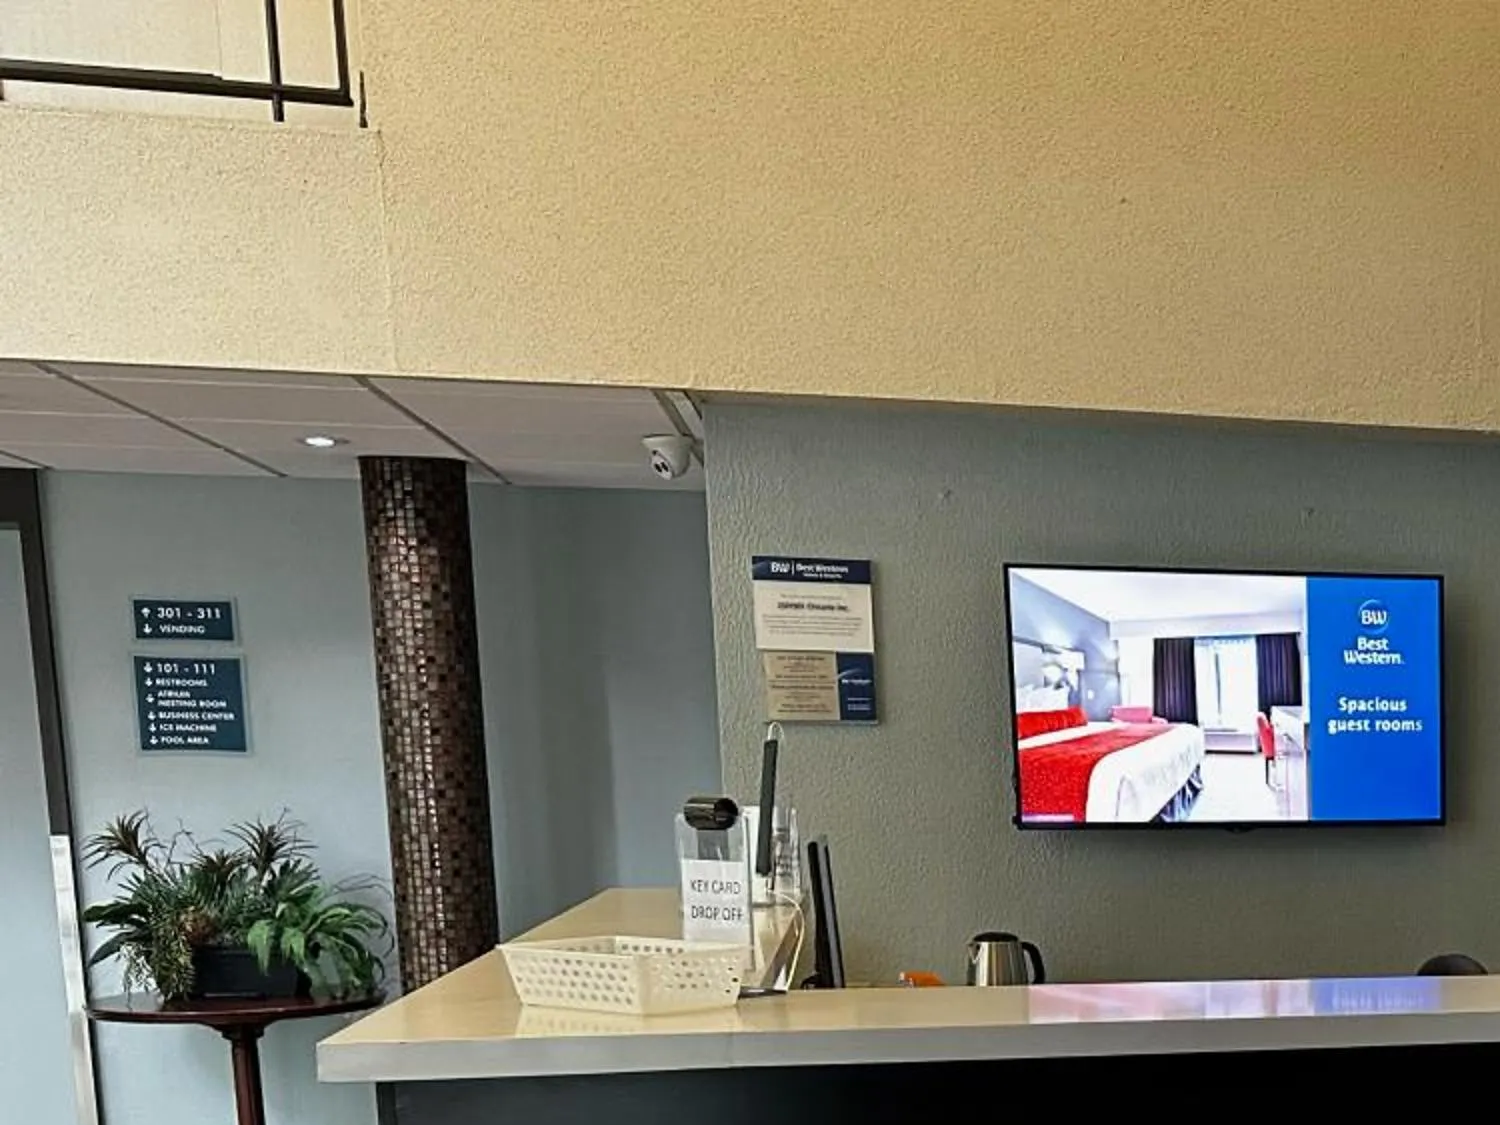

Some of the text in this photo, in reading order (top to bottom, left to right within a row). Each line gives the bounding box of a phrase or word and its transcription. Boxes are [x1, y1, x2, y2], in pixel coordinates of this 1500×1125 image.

[157, 607, 181, 619] 301
[197, 607, 221, 619] 311
[1361, 609, 1388, 625] BW
[159, 625, 206, 634] VENDING
[1357, 636, 1389, 650] Best
[1343, 650, 1402, 665] Western
[157, 663, 179, 673] 101
[194, 663, 216, 675] 111
[156, 679, 208, 687] RESTROOMS
[199, 700, 227, 708] ROOM
[1338, 696, 1408, 714] Spacious
[158, 712, 235, 720] BUSINESS CENTER
[176, 724, 217, 732] MACHINE
[1327, 719, 1423, 734] guest rooms
[689, 879, 742, 895] KEY CARD
[691, 905, 744, 921] DROP OFF
